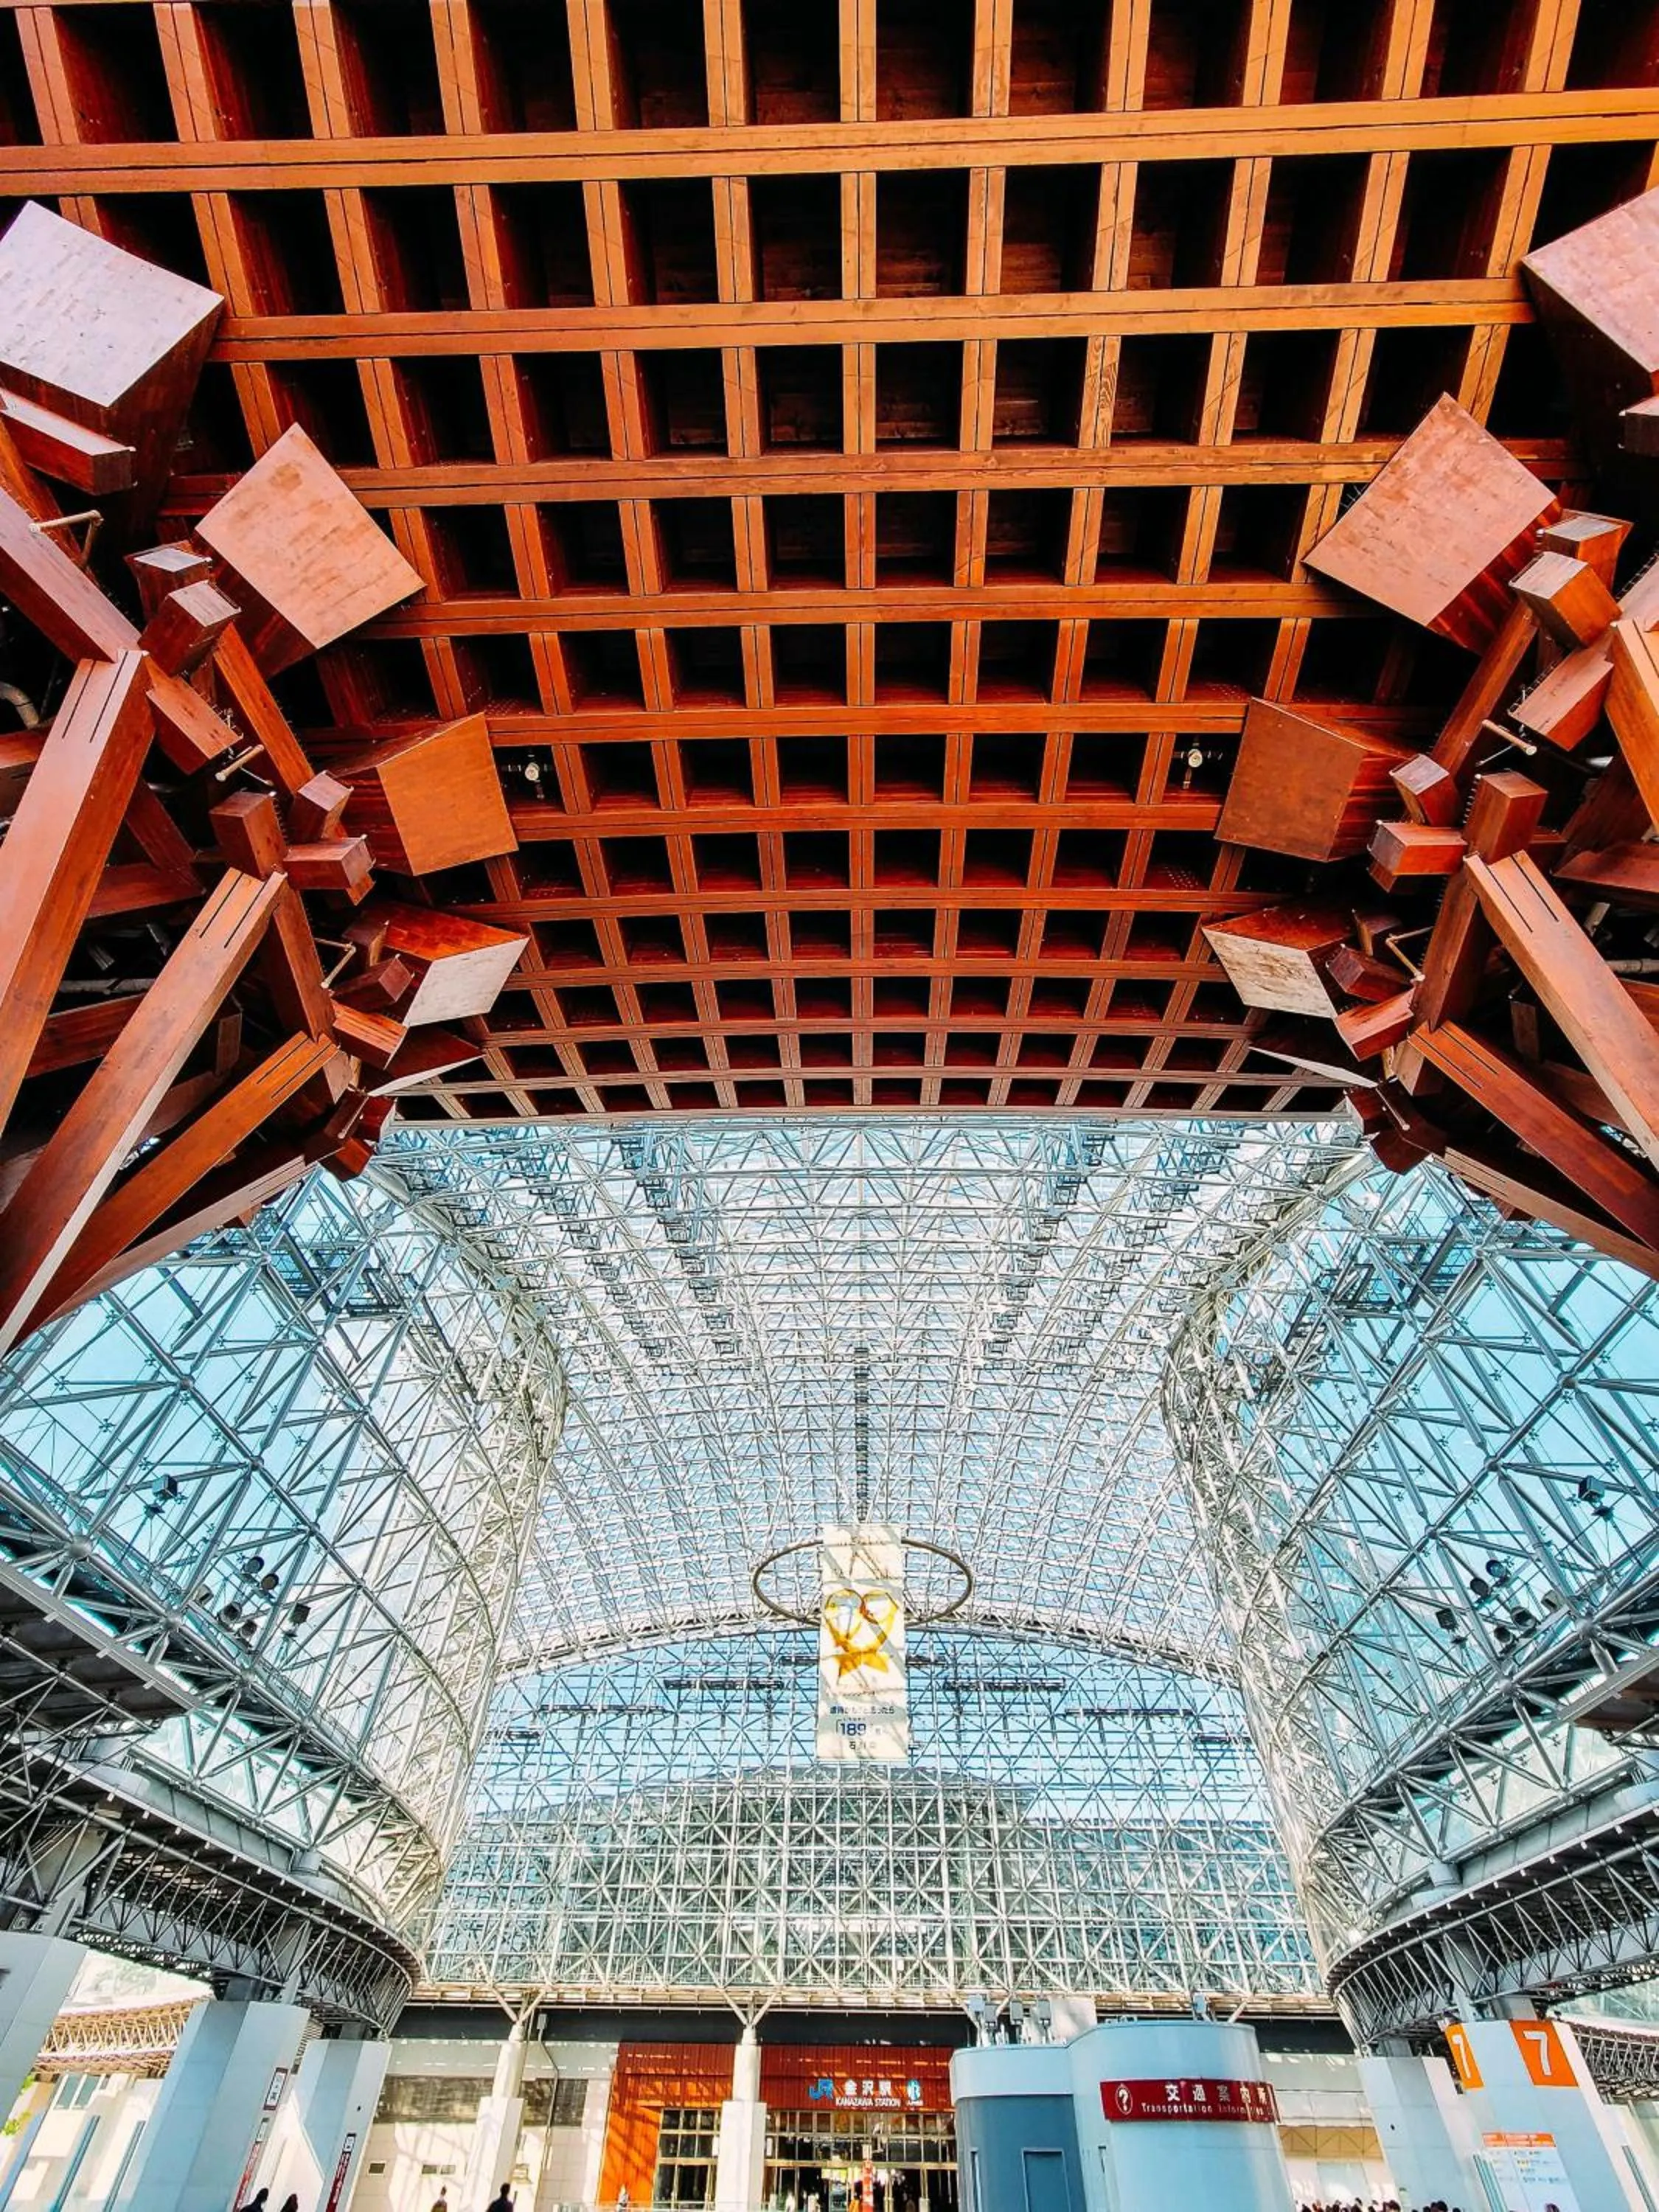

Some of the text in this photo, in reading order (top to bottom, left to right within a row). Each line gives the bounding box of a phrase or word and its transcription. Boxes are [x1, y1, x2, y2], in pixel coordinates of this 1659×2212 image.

[1523, 2031, 1551, 2076] 7
[809, 2079, 833, 2100] JR
[844, 2079, 891, 2096] 金沢駅
[1141, 2102, 1212, 2115] Transportation
